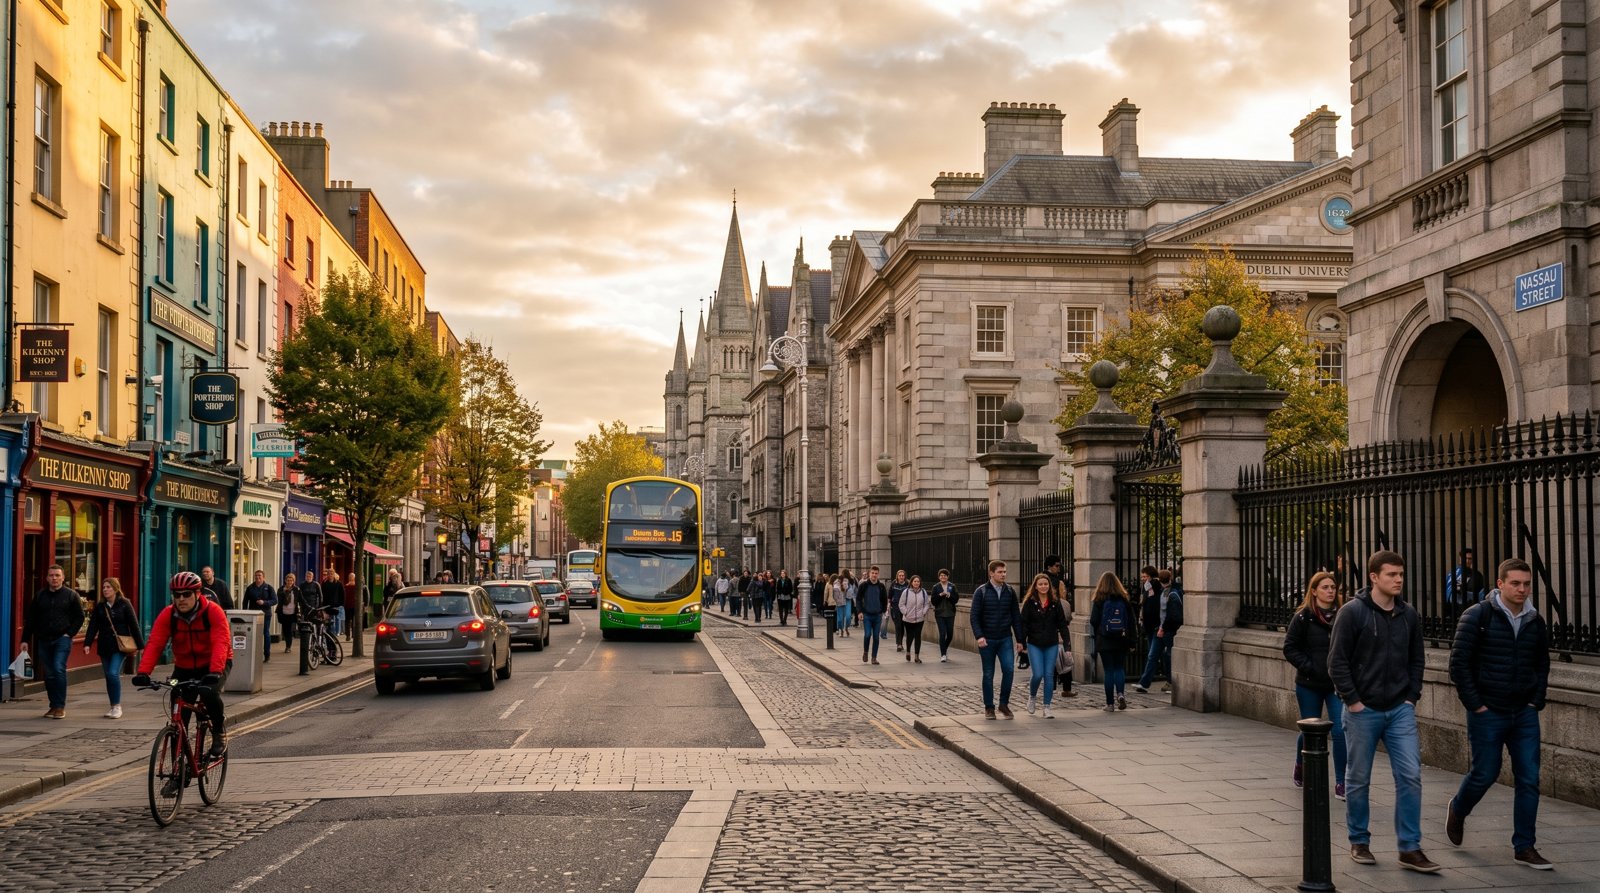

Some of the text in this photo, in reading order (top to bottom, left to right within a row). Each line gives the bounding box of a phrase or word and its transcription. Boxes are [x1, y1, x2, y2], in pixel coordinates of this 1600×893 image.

[1247, 265, 1350, 277] DUBLIN UNIVERS
[1520, 268, 1557, 291] NASSAU
[1522, 284, 1556, 306] STREET
[155, 298, 168, 321] THE
[35, 339, 53, 347] THE
[22, 348, 66, 356] KILKENNY
[207, 385, 222, 393] THE
[204, 402, 224, 410] SHOP
[38, 457, 131, 490] THE KILKENNY SHOP
[166, 480, 180, 498] THE
